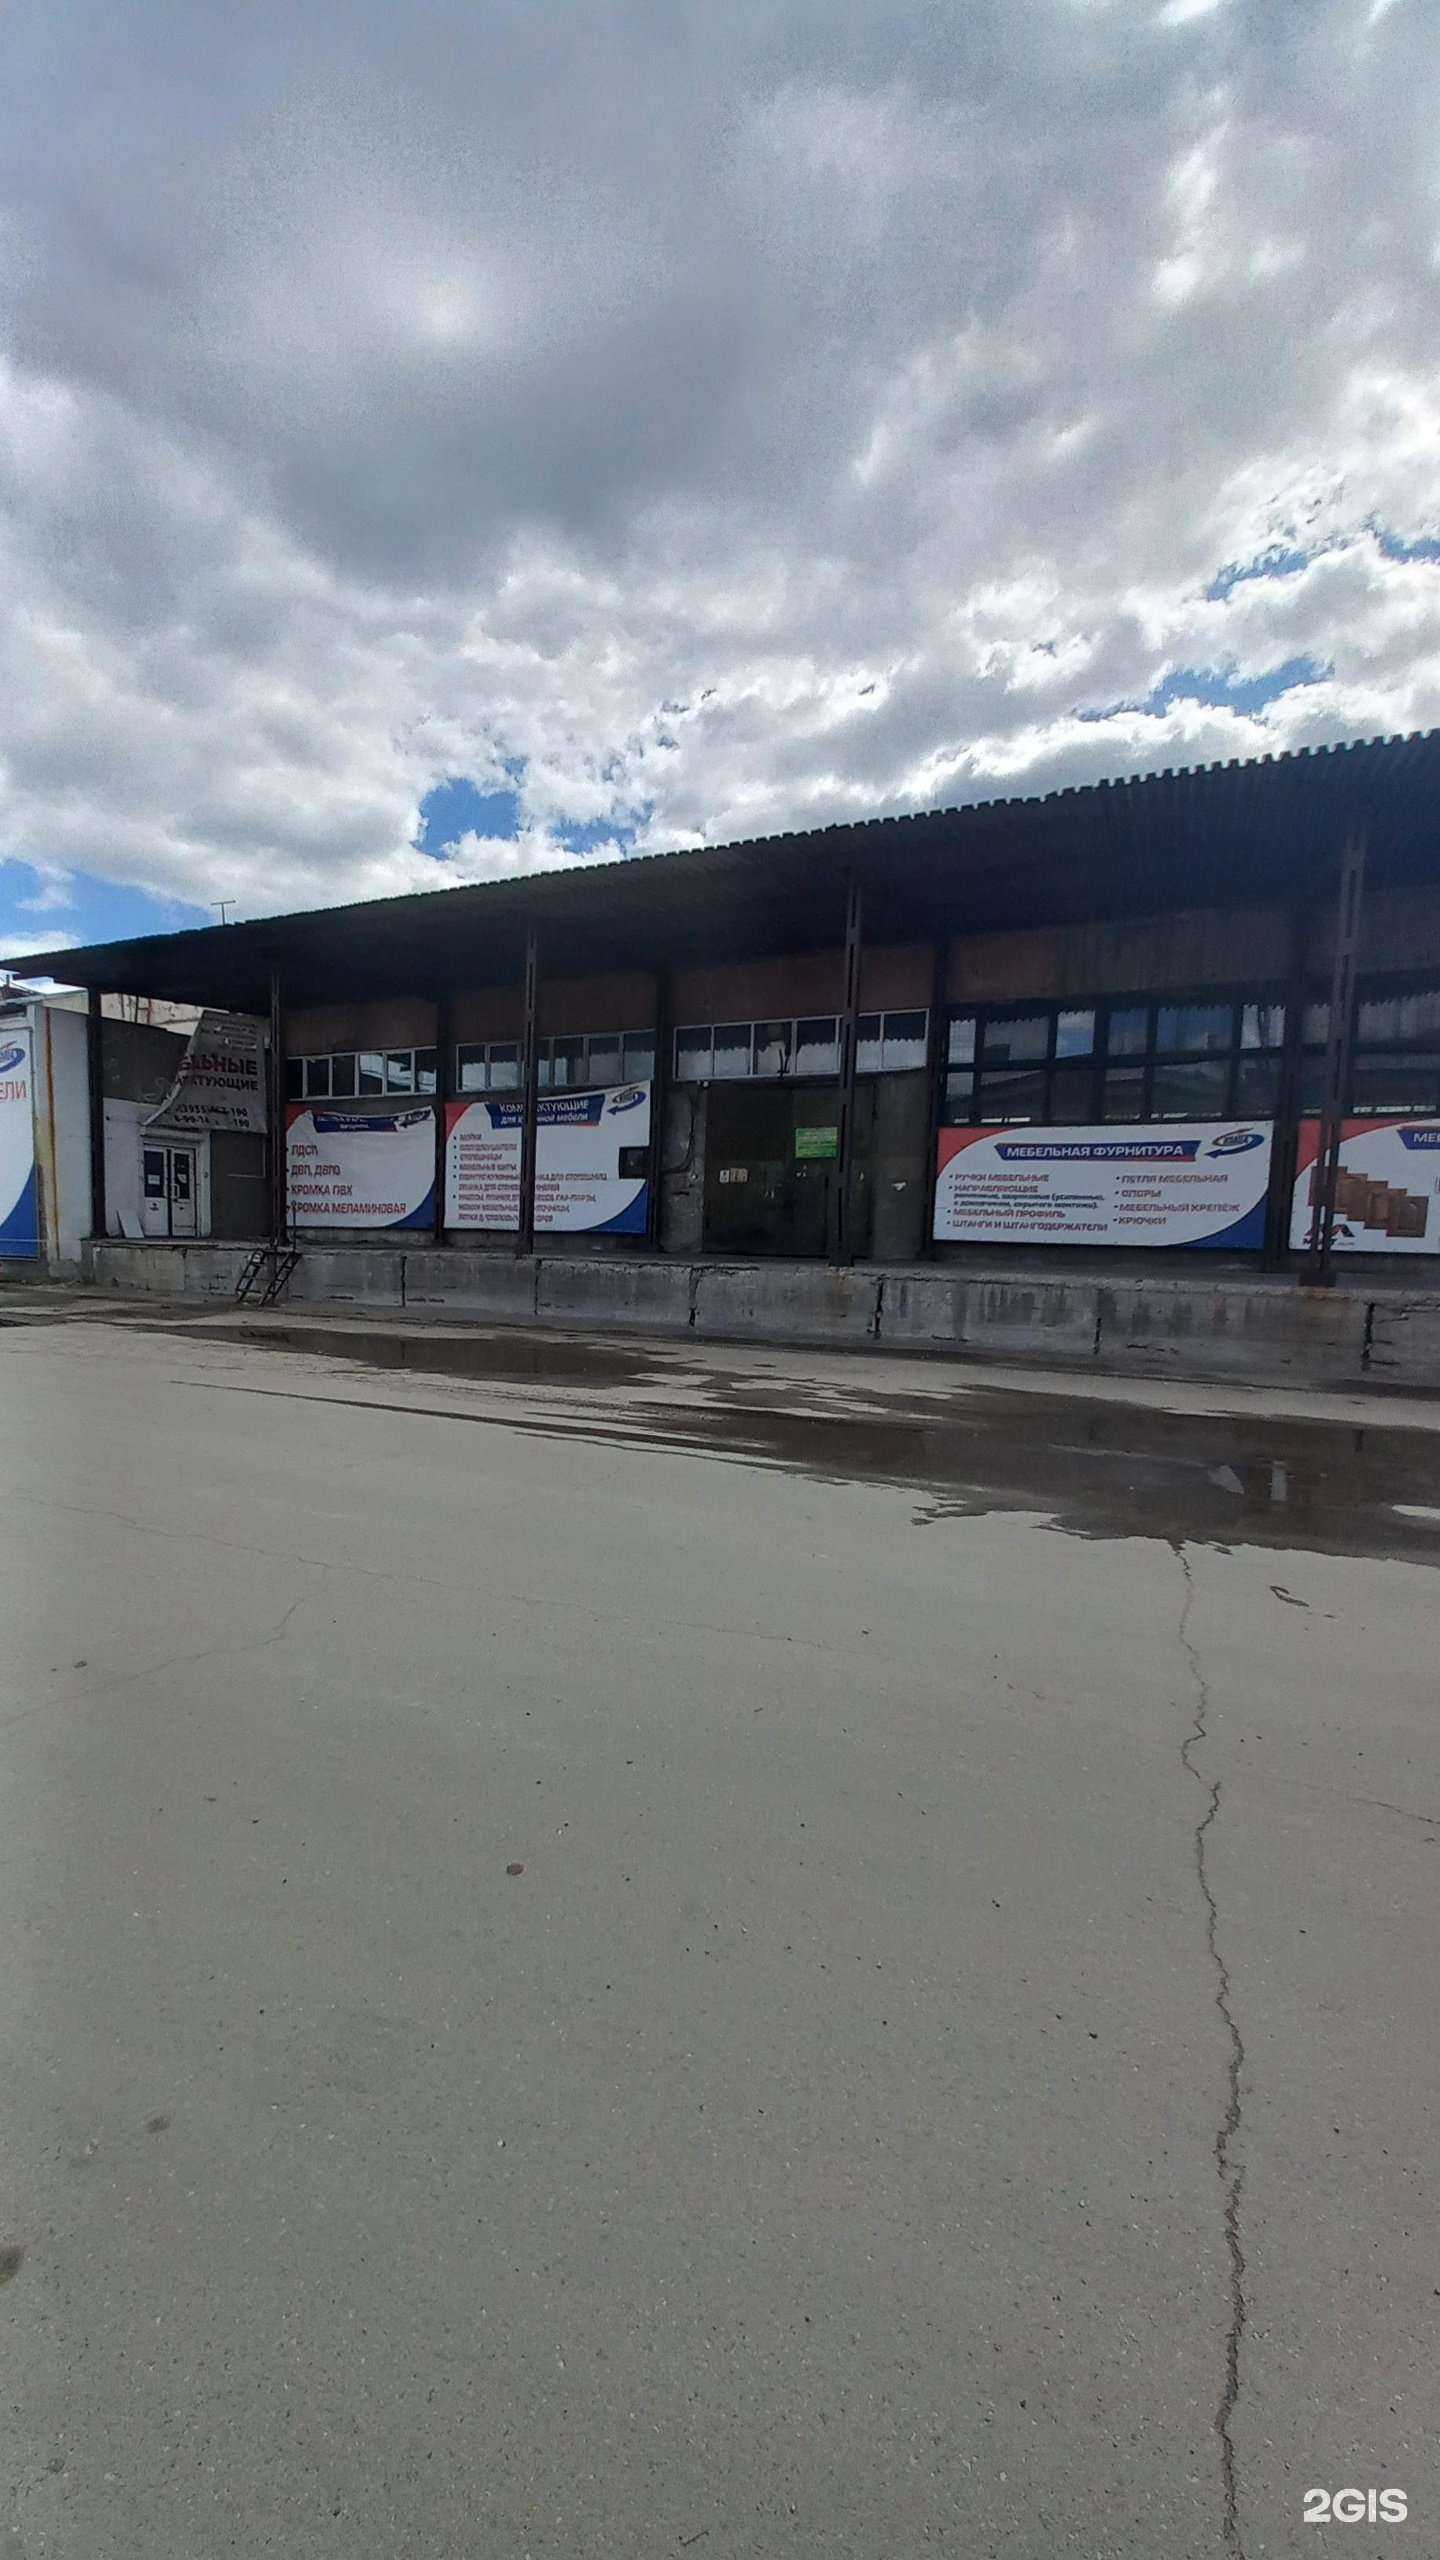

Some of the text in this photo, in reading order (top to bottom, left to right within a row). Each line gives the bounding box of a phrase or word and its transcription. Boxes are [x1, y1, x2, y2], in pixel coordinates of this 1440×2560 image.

[1007, 1144, 1184, 1158] МЕБЕЛЬНАЯ ФУРНИТУРА
[988, 1174, 1049, 1182] МЕБЕЛЬНЫЕ
[1121, 1174, 1228, 1183] ПЕТЛЯ МЕБЕЛЬНАЯ
[291, 1185, 353, 1196] КРОМКА ПВХ
[954, 1185, 1038, 1193] НАПРАВЛЯЮЩИЕ
[1121, 1190, 1161, 1198] ОПОРЫ
[332, 1203, 407, 1215] МЕЛАМИНОВАЯ
[1119, 1203, 1189, 1212] МЕБЕЛЬНЫЙ
[954, 1208, 1066, 1218] МЕБЕЛЬНЫЙ ПРОФИЛЬ
[953, 1220, 1108, 1231] ШТАНГИ И ШТАНГОДЕРЖАТЕЛИ
[1118, 1217, 1167, 1225] КРЮЧКИ
